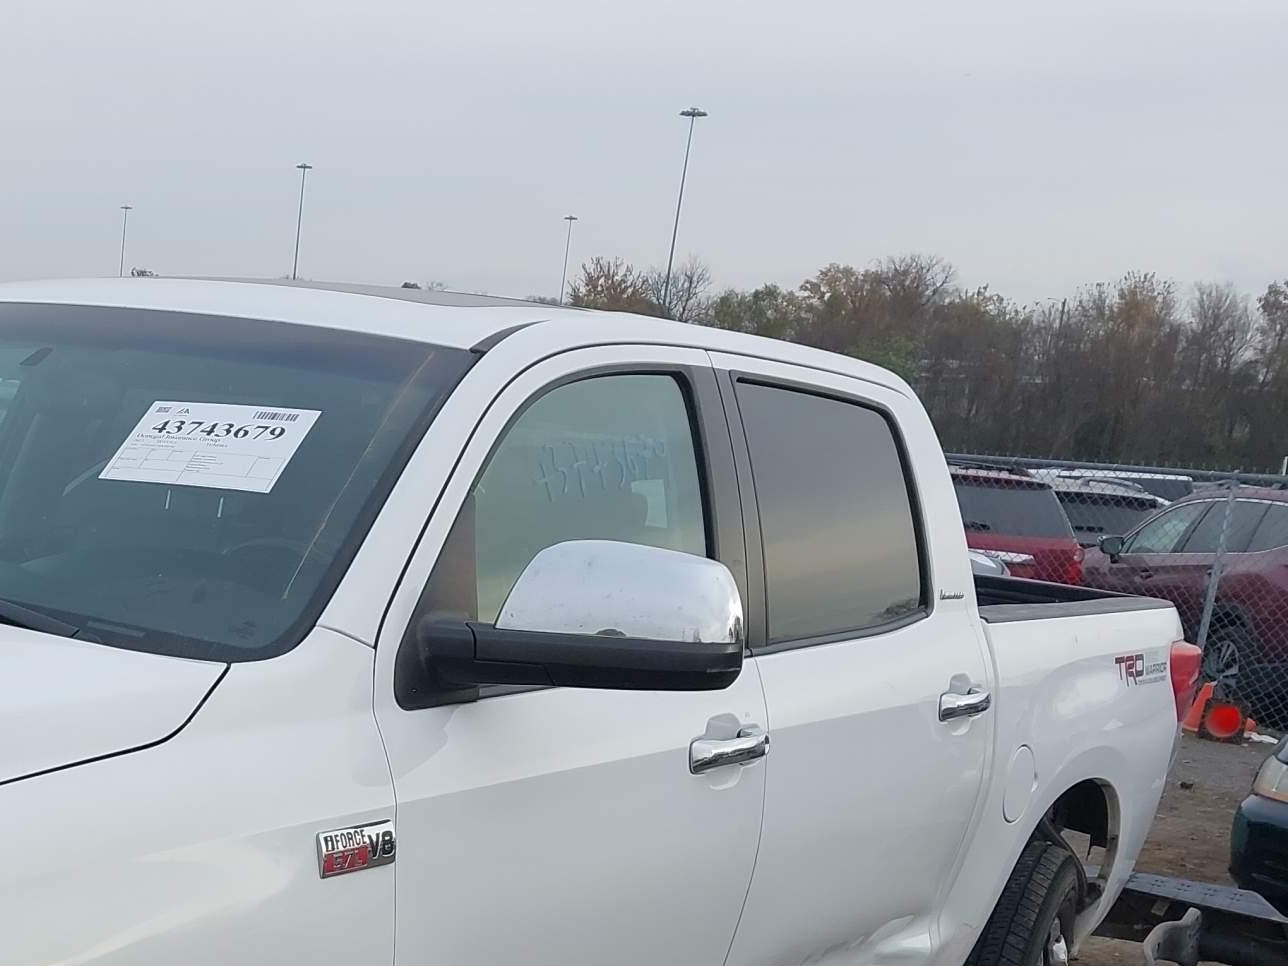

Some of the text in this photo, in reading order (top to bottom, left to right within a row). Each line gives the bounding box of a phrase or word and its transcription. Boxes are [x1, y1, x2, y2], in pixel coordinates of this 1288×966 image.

[151, 419, 287, 441] 43743679
[1114, 653, 1145, 687] TRD
[367, 830, 395, 859] V8
